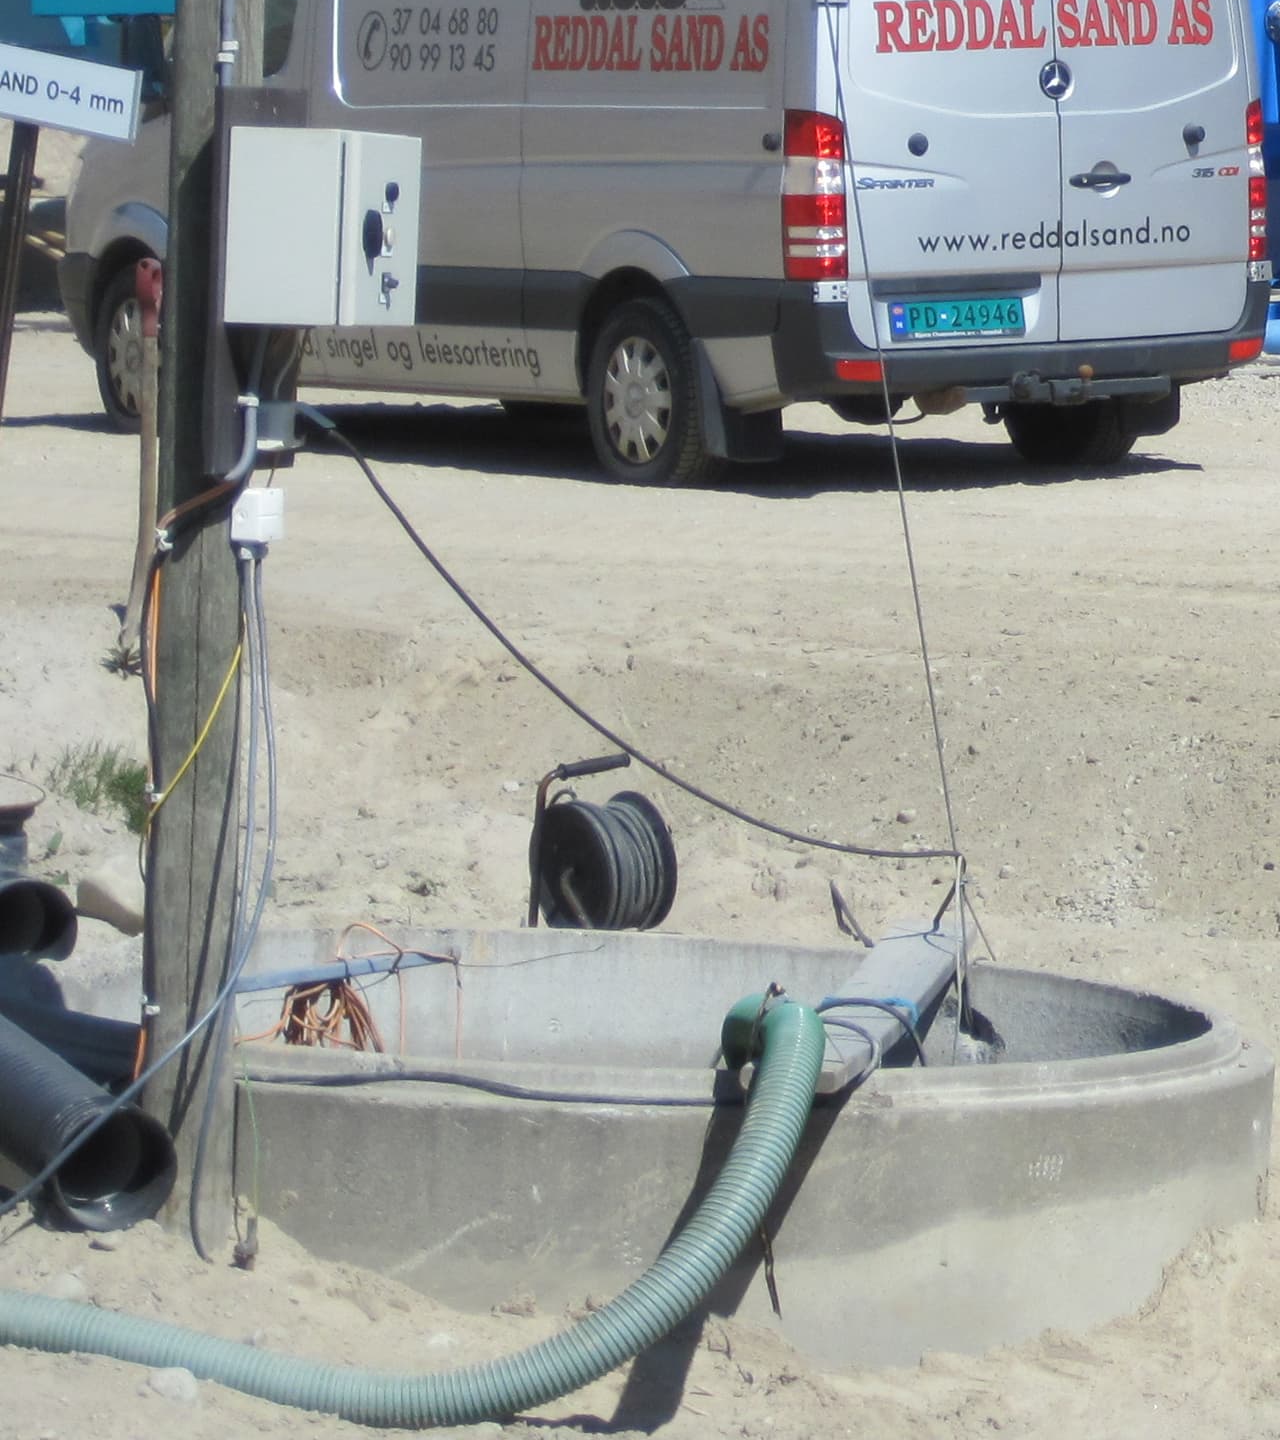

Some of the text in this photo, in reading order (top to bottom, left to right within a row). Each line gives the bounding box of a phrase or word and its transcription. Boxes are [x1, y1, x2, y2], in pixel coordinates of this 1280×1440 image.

[391, 7, 498, 35] 37 04 68 80
[389, 43, 496, 72] 90 99 13 45
[531, 14, 770, 72] REDDAL SAND AS
[46, 80, 82, 105] 0-4
[89, 94, 124, 115] mm
[917, 217, 1191, 253] www.reddalsand.no
[908, 303, 1020, 329] PD 24946
[326, 328, 379, 368] singel
[386, 339, 413, 370] og
[417, 330, 542, 377] leiesortering
